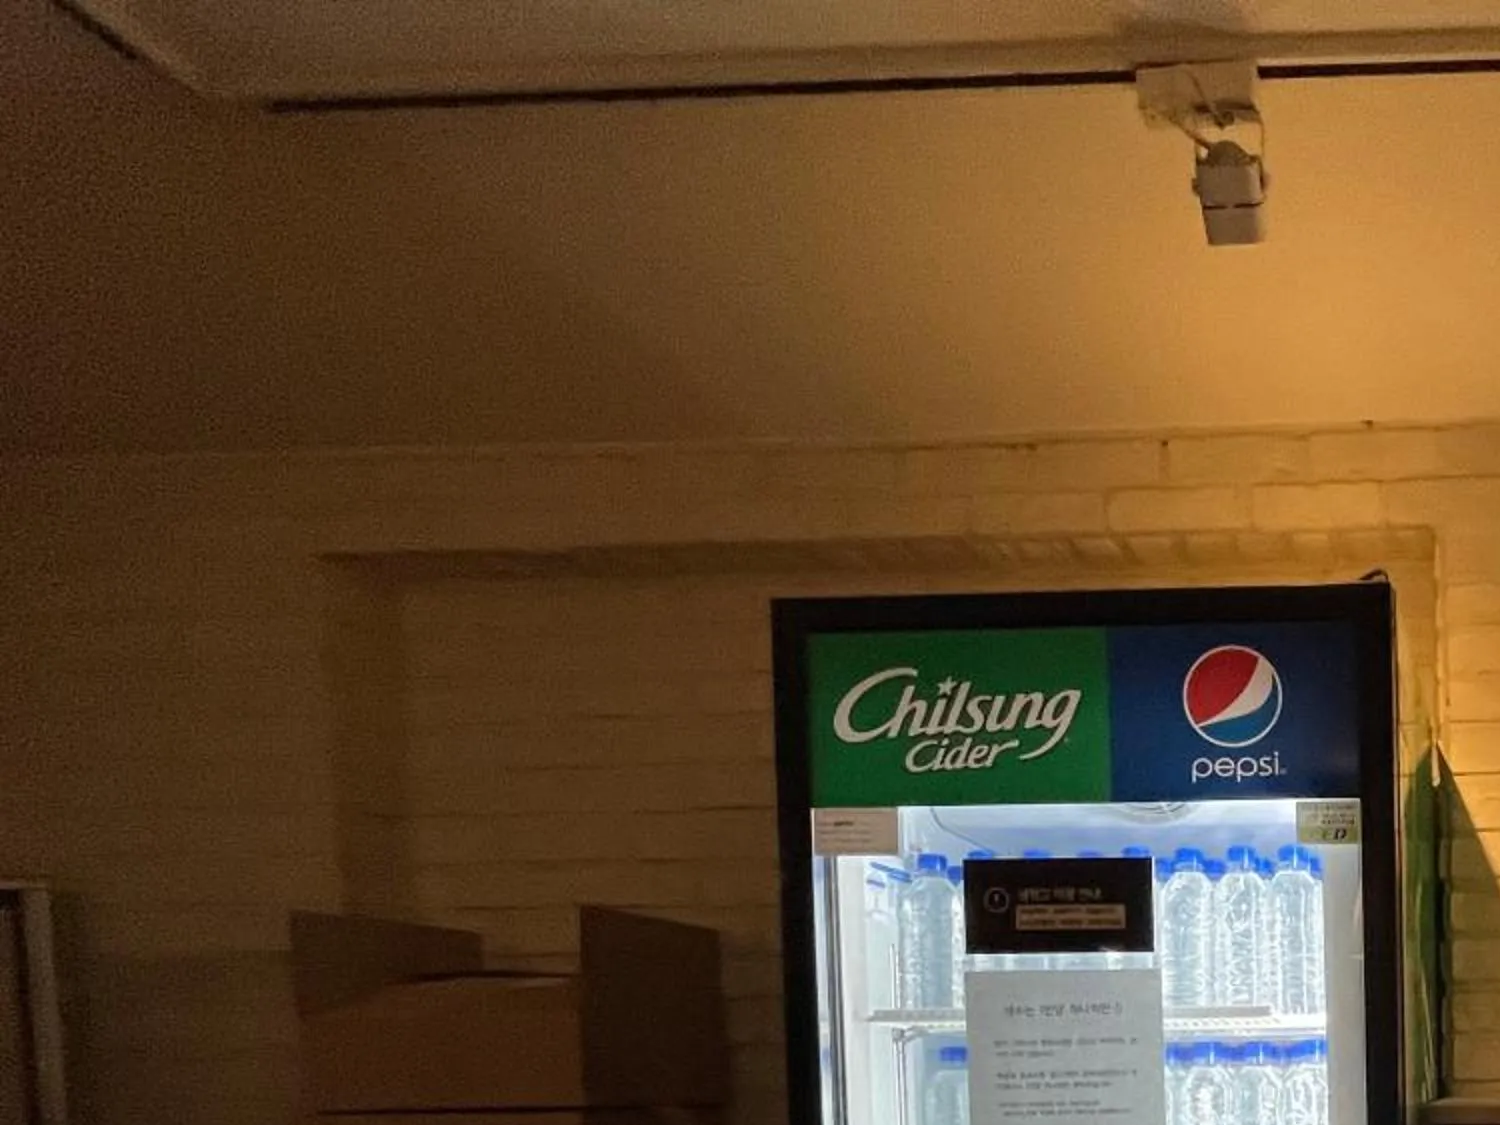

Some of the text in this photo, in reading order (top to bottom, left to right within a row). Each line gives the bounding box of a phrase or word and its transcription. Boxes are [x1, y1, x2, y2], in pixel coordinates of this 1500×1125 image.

[832, 667, 1082, 759] Chilsung
[905, 736, 1020, 773] Cider
[1191, 751, 1280, 782] pepsi
